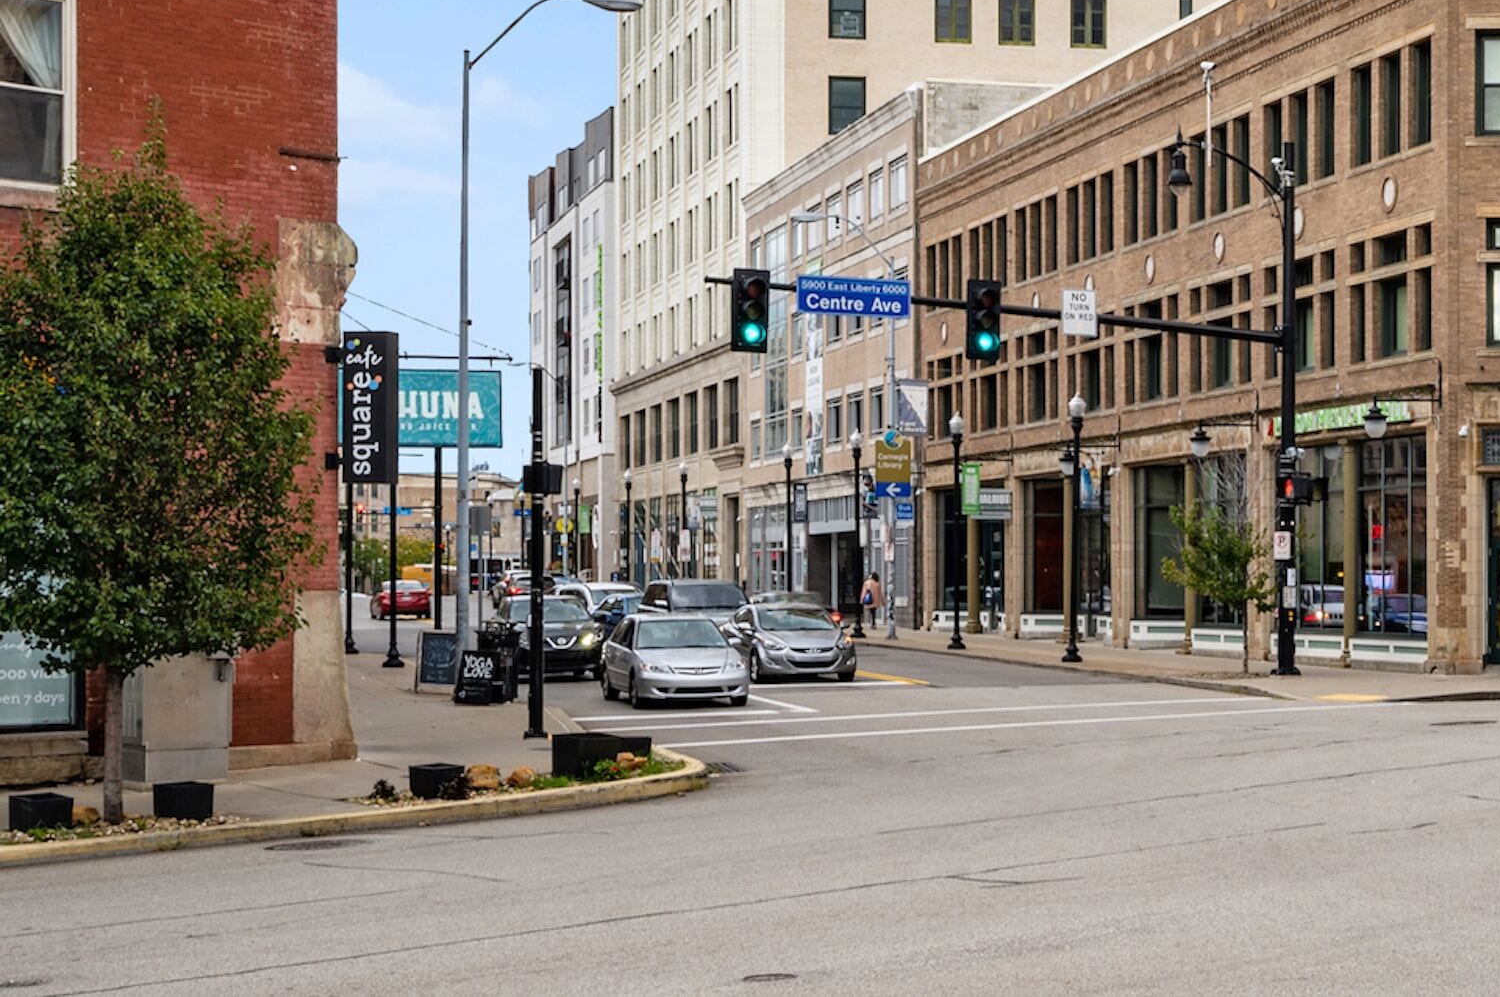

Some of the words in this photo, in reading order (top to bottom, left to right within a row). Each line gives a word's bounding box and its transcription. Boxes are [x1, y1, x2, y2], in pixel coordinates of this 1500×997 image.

[827, 283, 848, 292] East
[850, 283, 881, 295] Liberty
[882, 284, 907, 294] 6000
[1071, 292, 1087, 302] NO
[805, 293, 865, 312] Centre
[870, 297, 902, 314] Ave
[1069, 303, 1090, 312] TURN
[1064, 312, 1076, 320] ON
[1078, 313, 1095, 322] RED
[345, 344, 384, 369] cafe
[352, 371, 380, 476] square
[877, 453, 909, 461] Carnegie
[877, 462, 902, 470] Library
[464, 655, 494, 669] YOGA
[463, 668, 492, 679] LOVE
[0, 694, 20, 705] en
[24, 694, 31, 707] 7
[34, 690, 65, 707] days
